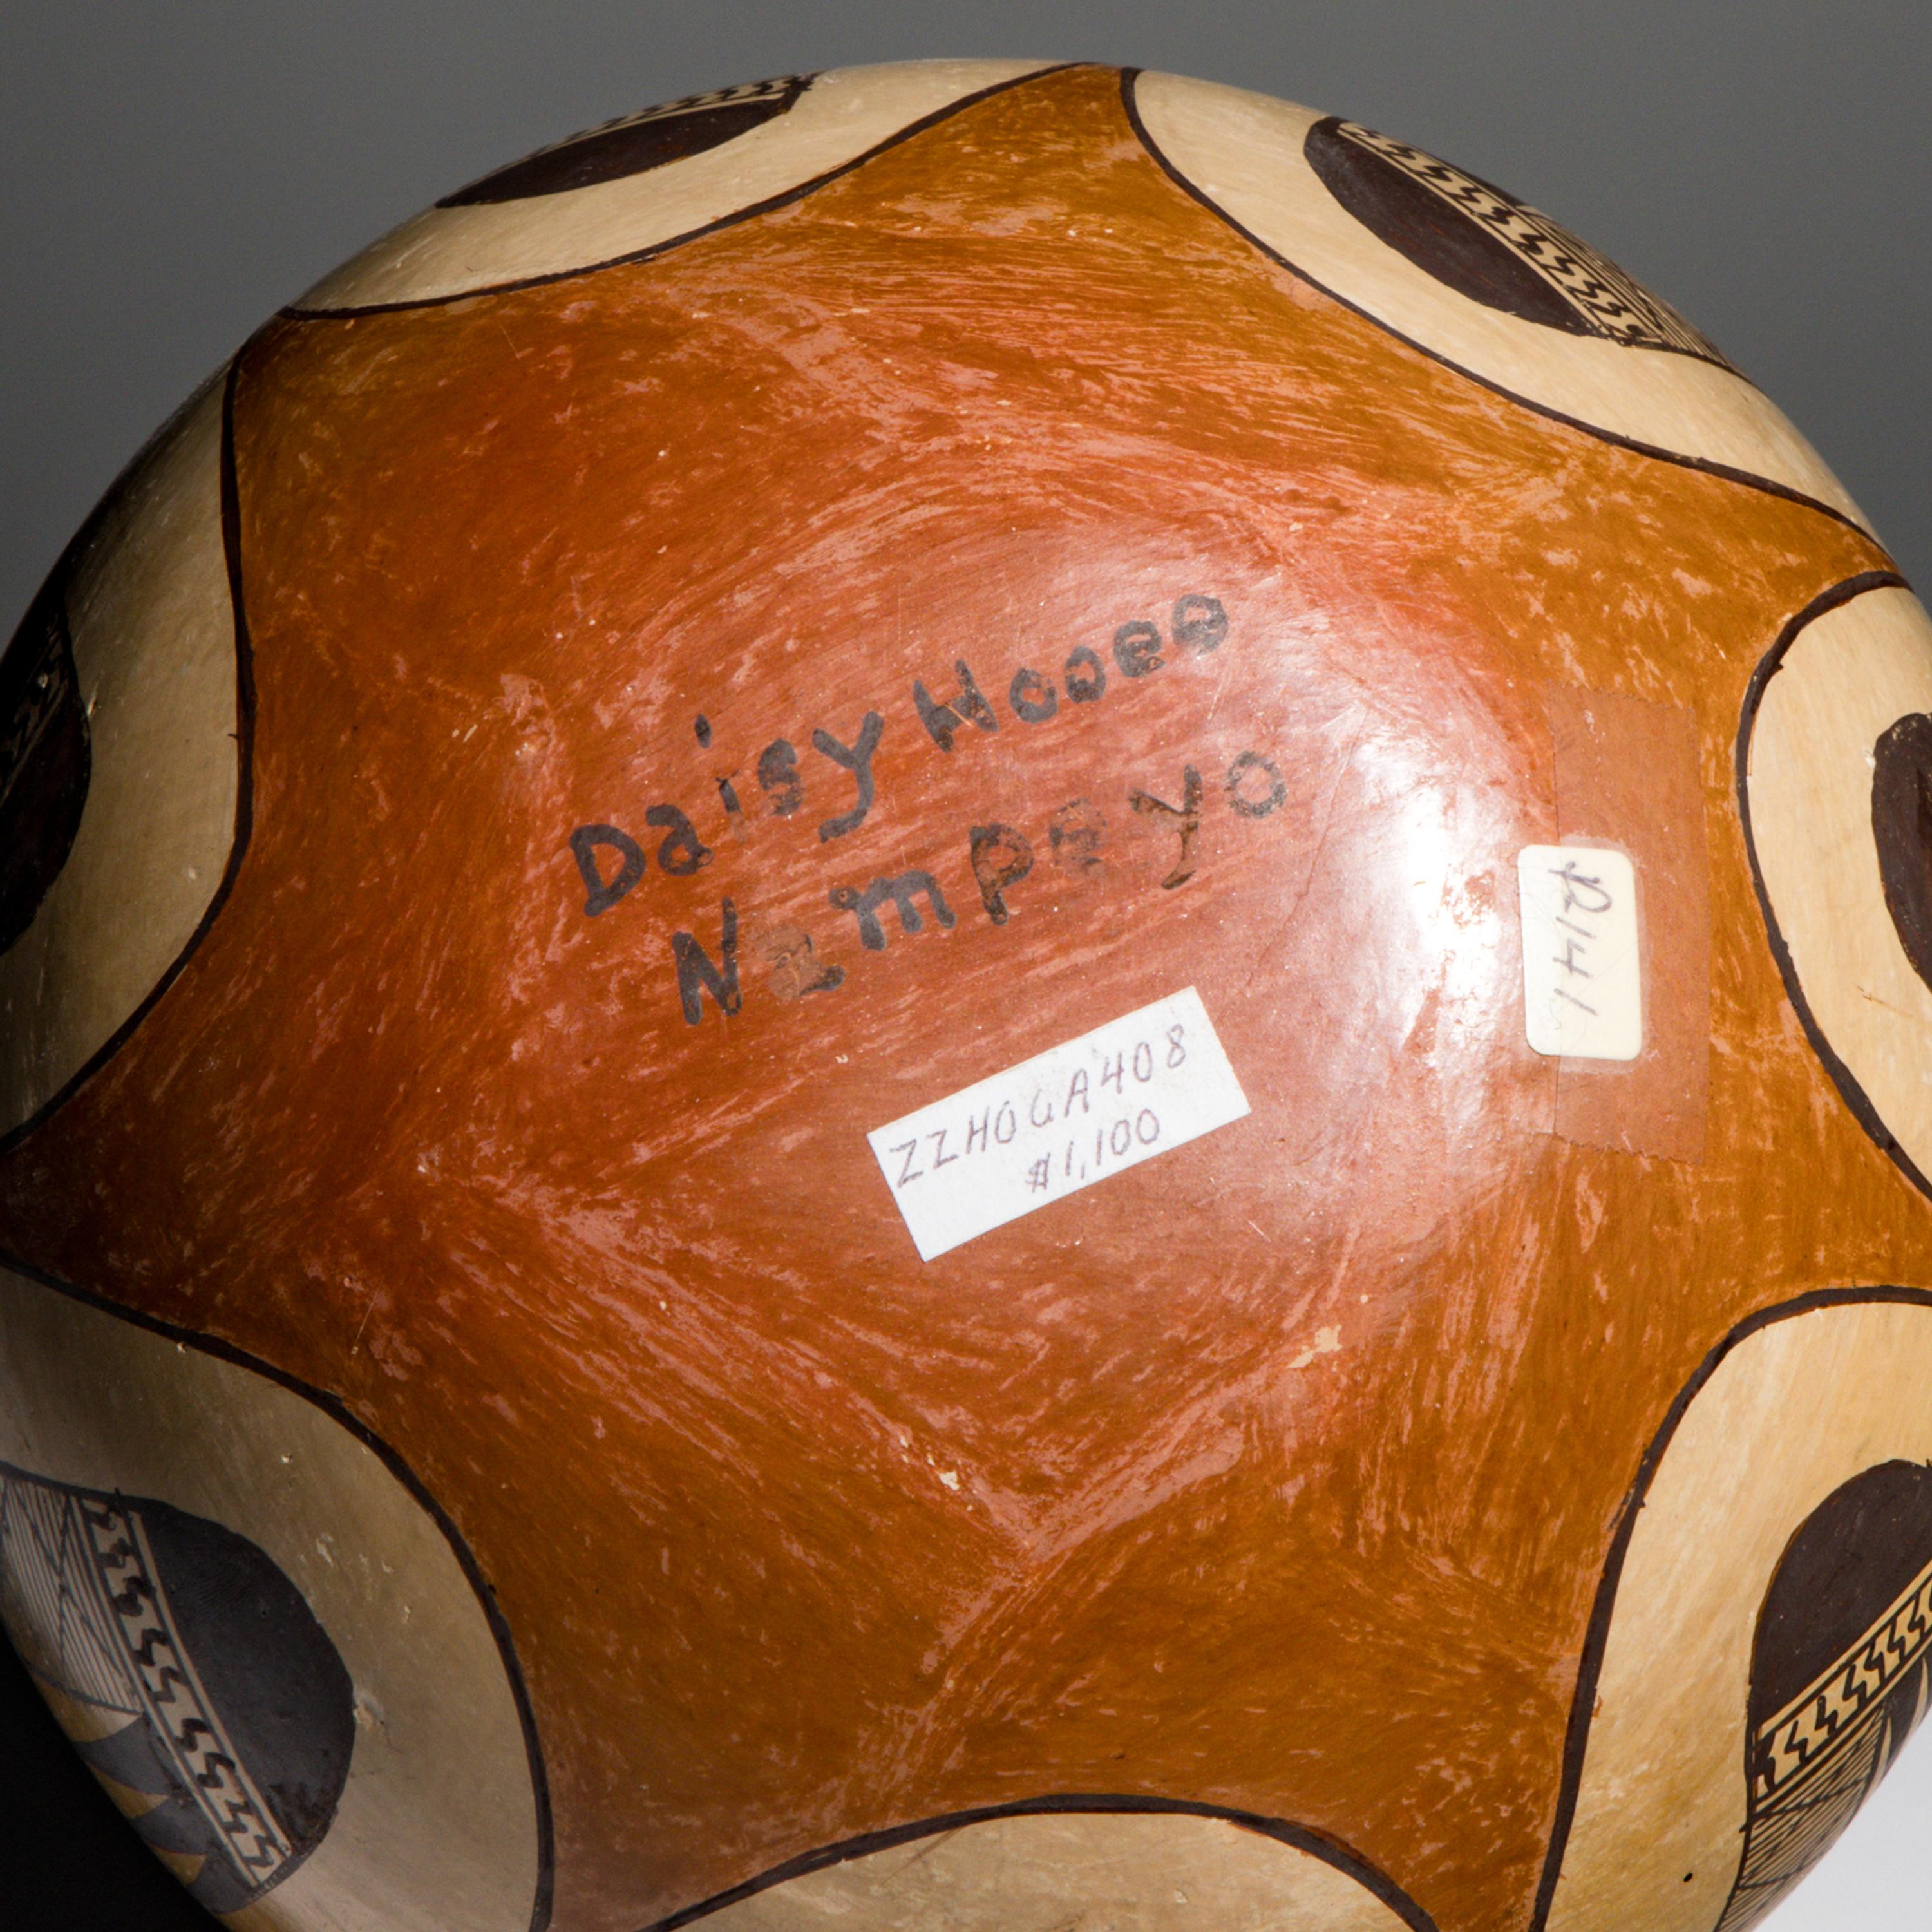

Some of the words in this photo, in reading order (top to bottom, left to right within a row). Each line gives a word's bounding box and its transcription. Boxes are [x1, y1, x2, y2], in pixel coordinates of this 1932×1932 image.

[569, 710, 884, 917] Daisy
[913, 594, 1229, 752] Hooee
[1025, 1108, 1160, 1193] $1,100
